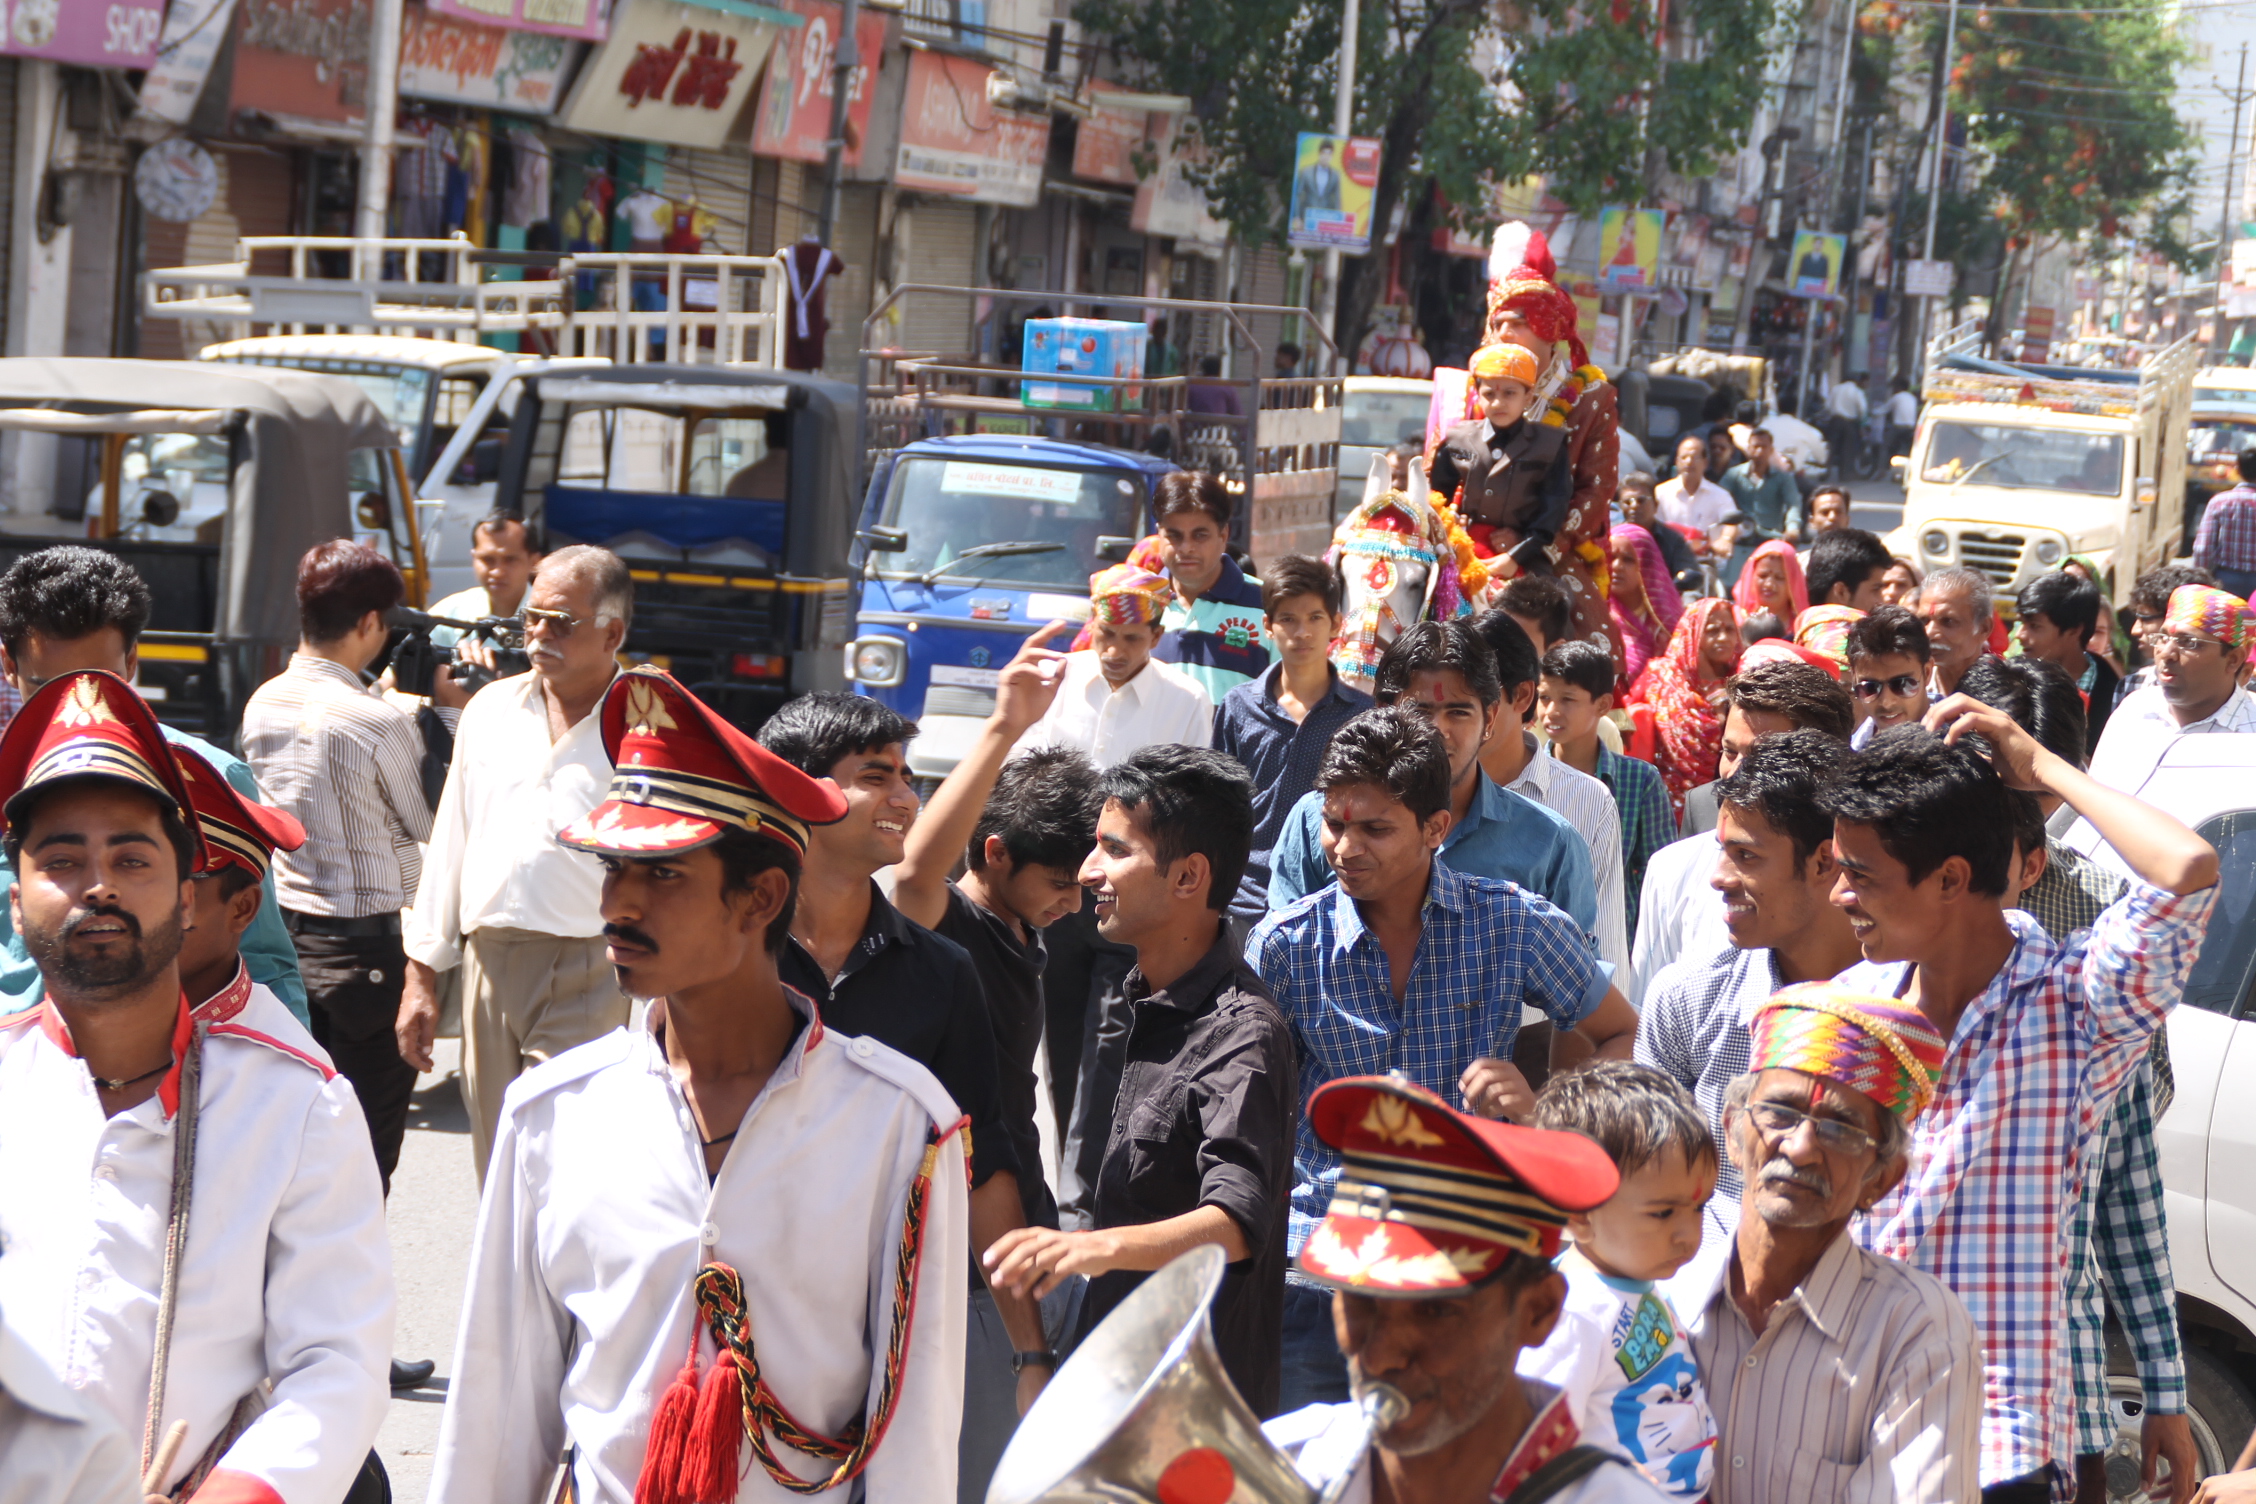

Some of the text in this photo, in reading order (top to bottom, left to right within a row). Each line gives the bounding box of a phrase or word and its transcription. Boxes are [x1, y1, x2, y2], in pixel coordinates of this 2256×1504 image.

[104, 3, 160, 55] SHOP
[1225, 628, 1249, 648] 23
[1612, 1301, 1636, 1349] START
[1624, 1299, 1659, 1358] DORA
